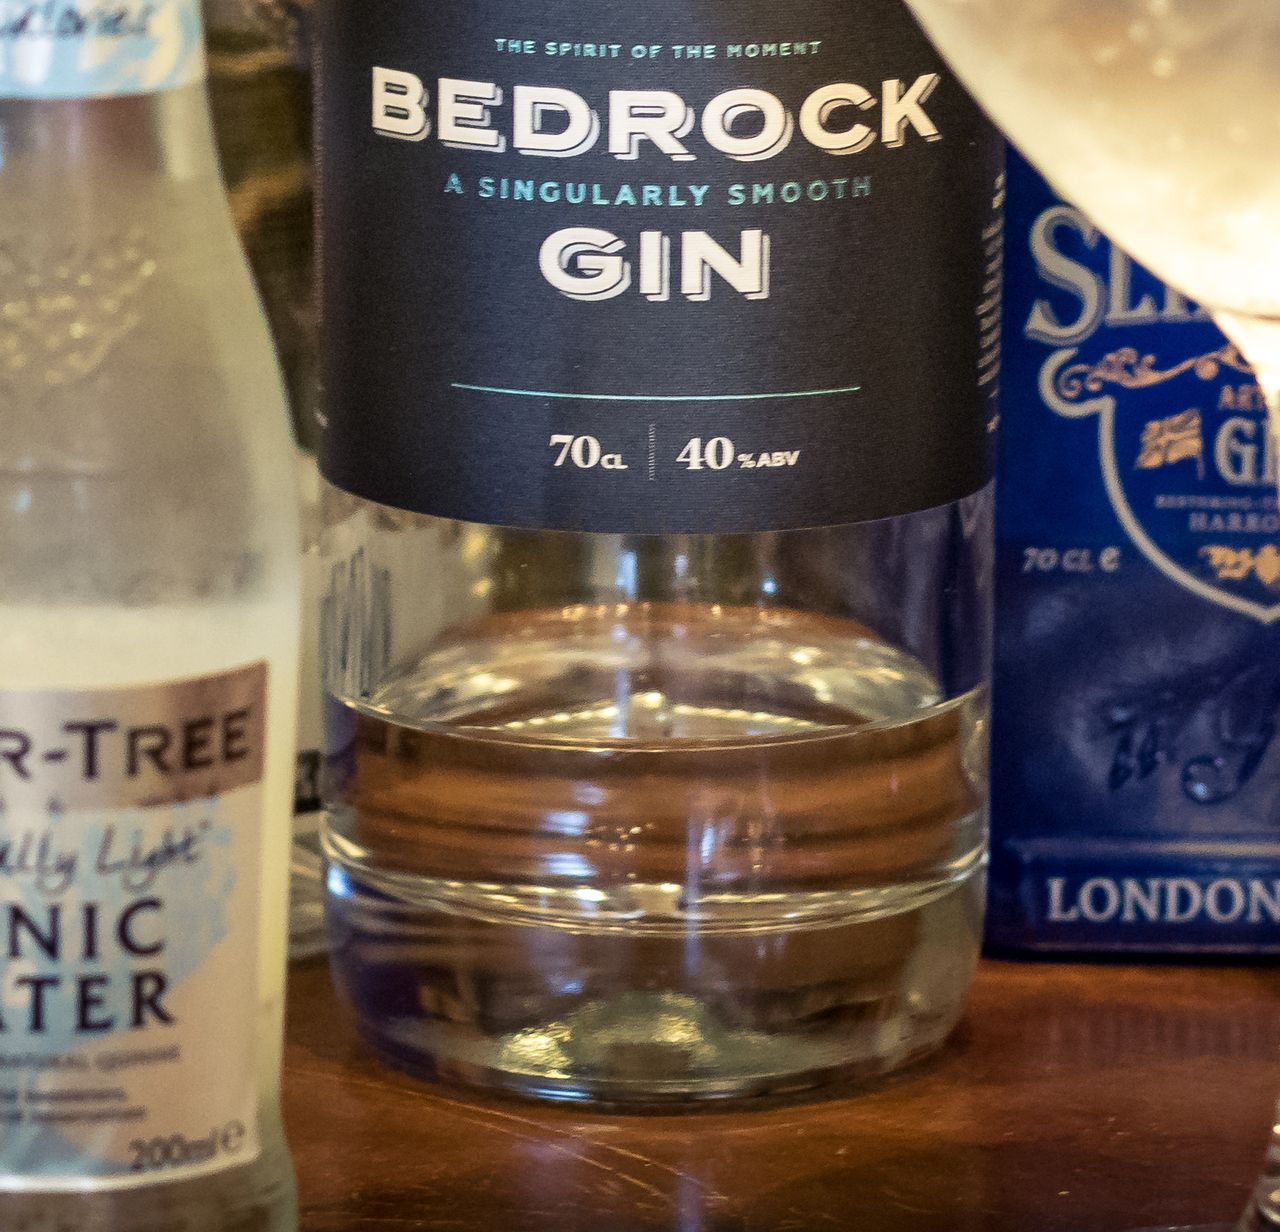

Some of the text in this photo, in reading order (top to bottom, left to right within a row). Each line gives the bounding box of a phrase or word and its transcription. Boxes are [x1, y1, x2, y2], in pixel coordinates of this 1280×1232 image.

[493, 38, 823, 60] THE SPIRIT OF THE MOMENT
[371, 65, 944, 162] BEDROCK
[443, 172, 871, 207] A SINGULARLY SMOOTH
[538, 227, 771, 302] GIN
